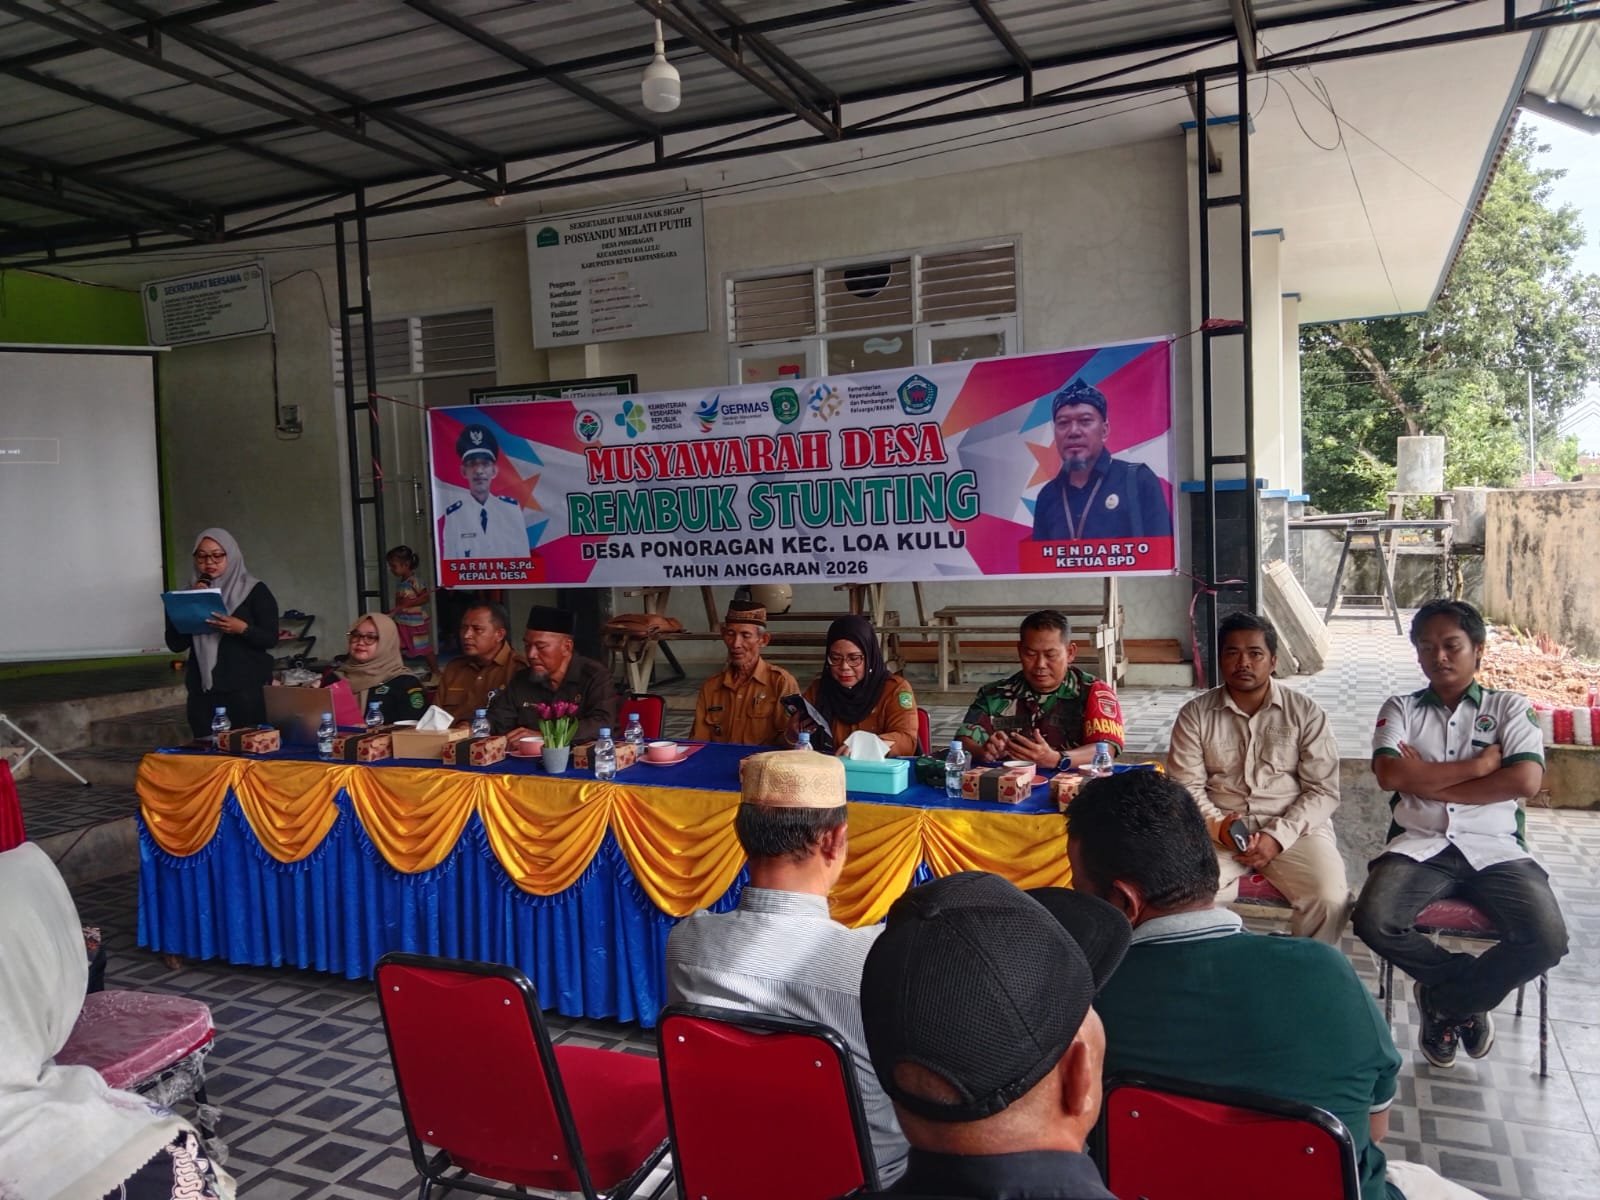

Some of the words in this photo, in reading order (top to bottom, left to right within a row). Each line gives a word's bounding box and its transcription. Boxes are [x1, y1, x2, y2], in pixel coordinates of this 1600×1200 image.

[617, 212, 642, 224] RUMAH
[643, 209, 663, 220] ANAK
[664, 206, 685, 217] SIGAP
[564, 228, 616, 245] POSYANDU
[618, 222, 658, 238] MELATI
[660, 217, 692, 230] PUTIH
[209, 272, 242, 288] BERSAMA
[650, 409, 682, 417] KESEHATAN
[721, 401, 770, 415] GERMAS
[585, 431, 831, 484] MUSYAWARAH
[840, 422, 948, 471] DESA
[567, 484, 742, 536] REMBUK
[748, 471, 980, 532] STUNTING
[582, 541, 634, 560] DESA
[641, 537, 775, 558] PONORAGAN
[781, 536, 836, 554] KEC.
[842, 534, 890, 552] LOA
[896, 530, 966, 550] KULU
[663, 564, 722, 578] TAHUN
[724, 562, 824, 577] ANGGARAN
[825, 561, 868, 575] 2026
[1056, 556, 1104, 568] KETUA
[1107, 555, 1136, 567] BPD
[458, 572, 498, 582] KEPALA
[500, 571, 528, 581] DESA
[1085, 718, 1125, 740] BABINS
